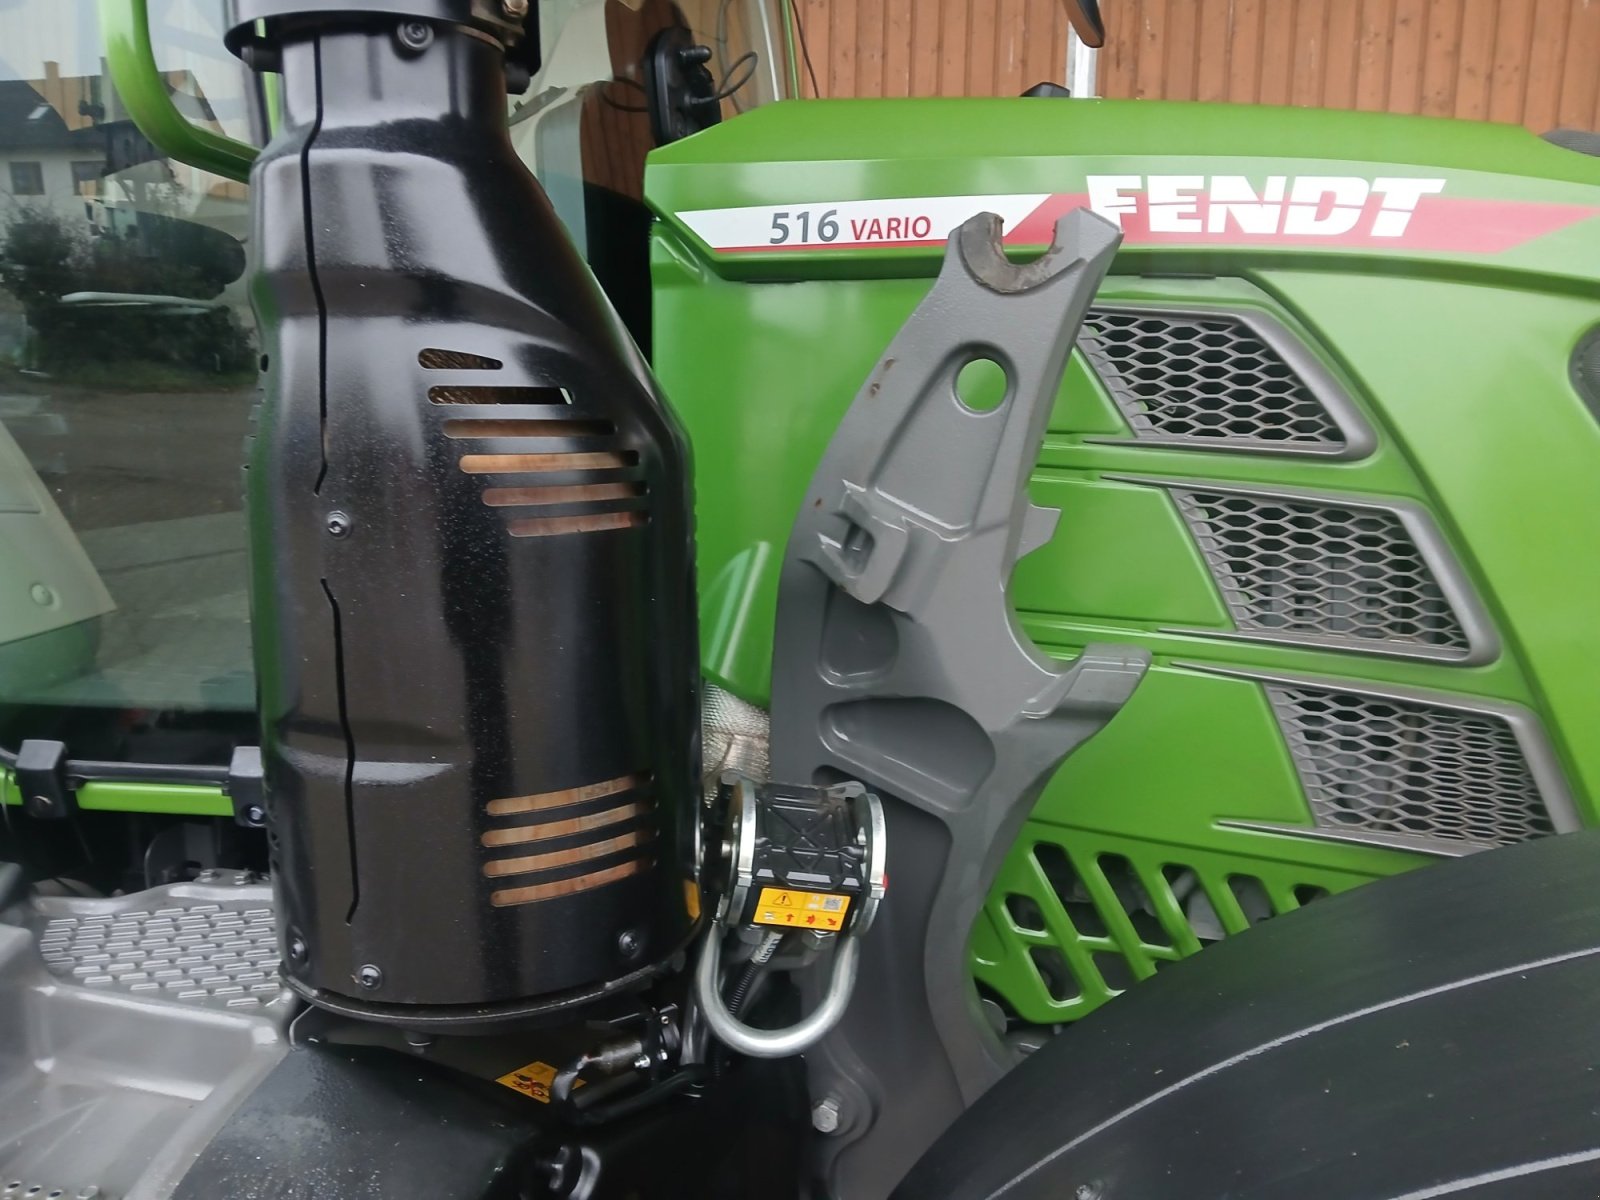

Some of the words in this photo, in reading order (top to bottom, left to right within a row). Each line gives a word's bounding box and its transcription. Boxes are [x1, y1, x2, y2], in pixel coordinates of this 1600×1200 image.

[770, 210, 839, 244] 516
[851, 216, 931, 241] VARIO
[1086, 175, 1446, 236] FENDT
